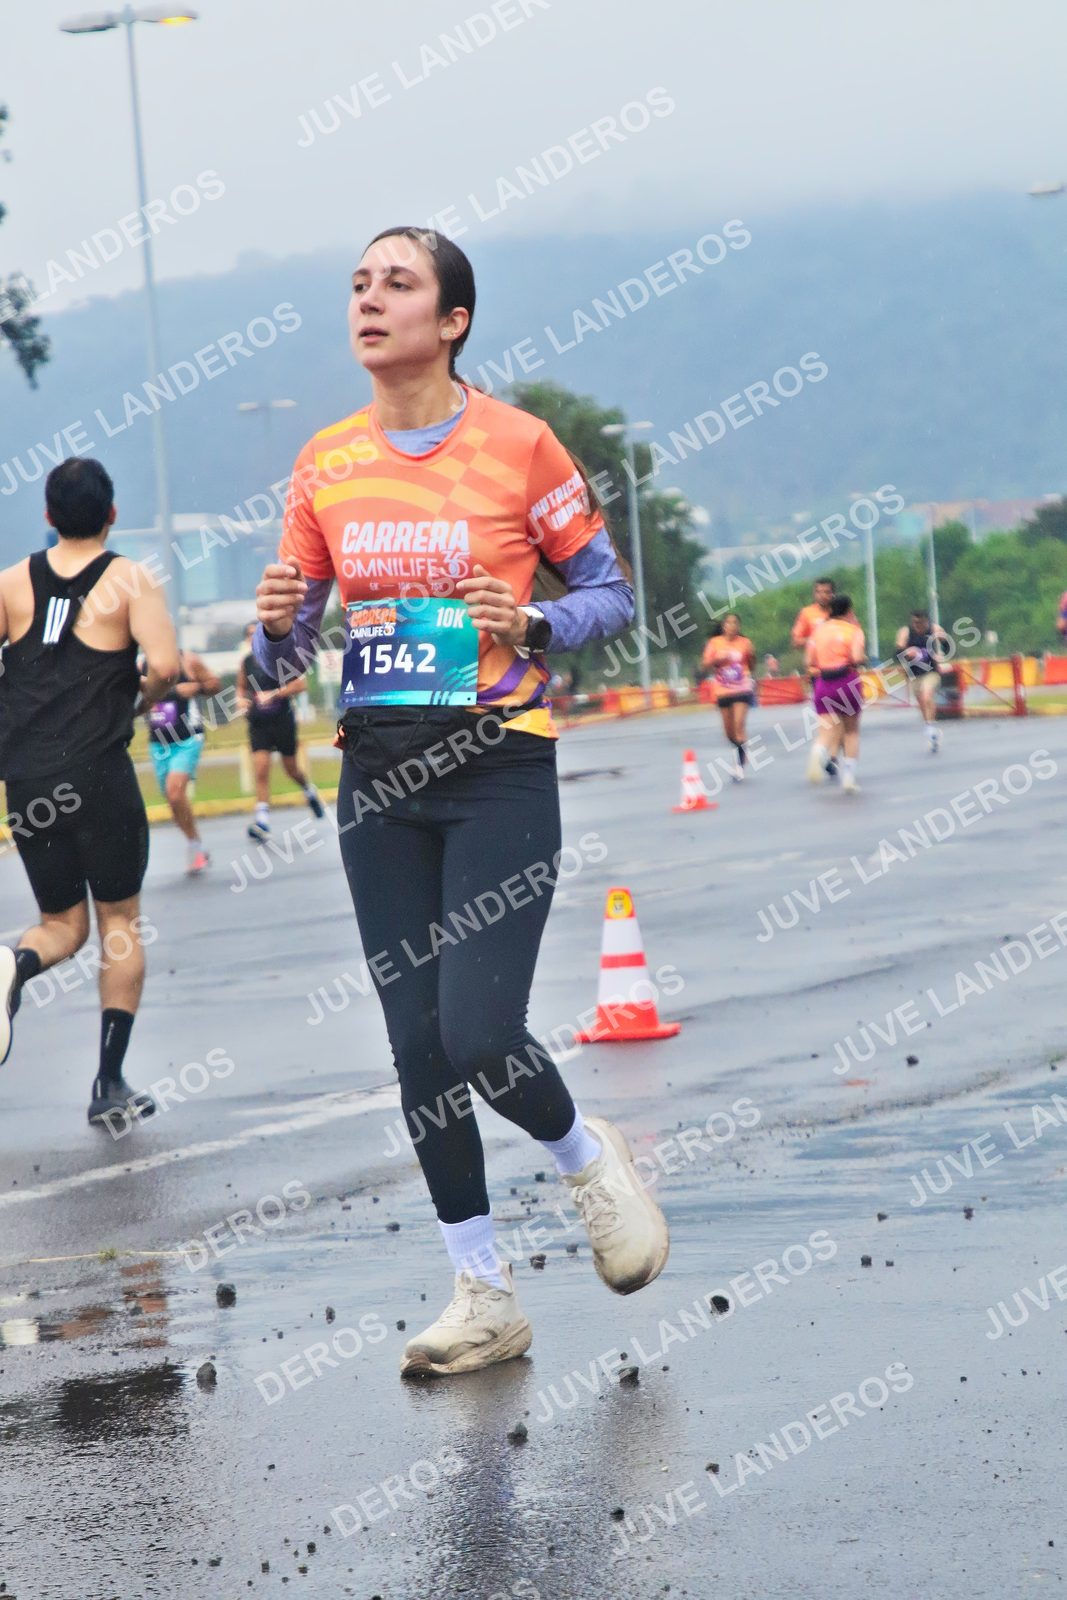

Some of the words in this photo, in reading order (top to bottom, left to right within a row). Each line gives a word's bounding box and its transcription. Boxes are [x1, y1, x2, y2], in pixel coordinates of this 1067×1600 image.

[342, 520, 470, 554] CARRERA
[342, 557, 440, 578] OMNILIFE
[436, 606, 467, 629] 10K
[359, 643, 436, 675] 1542
